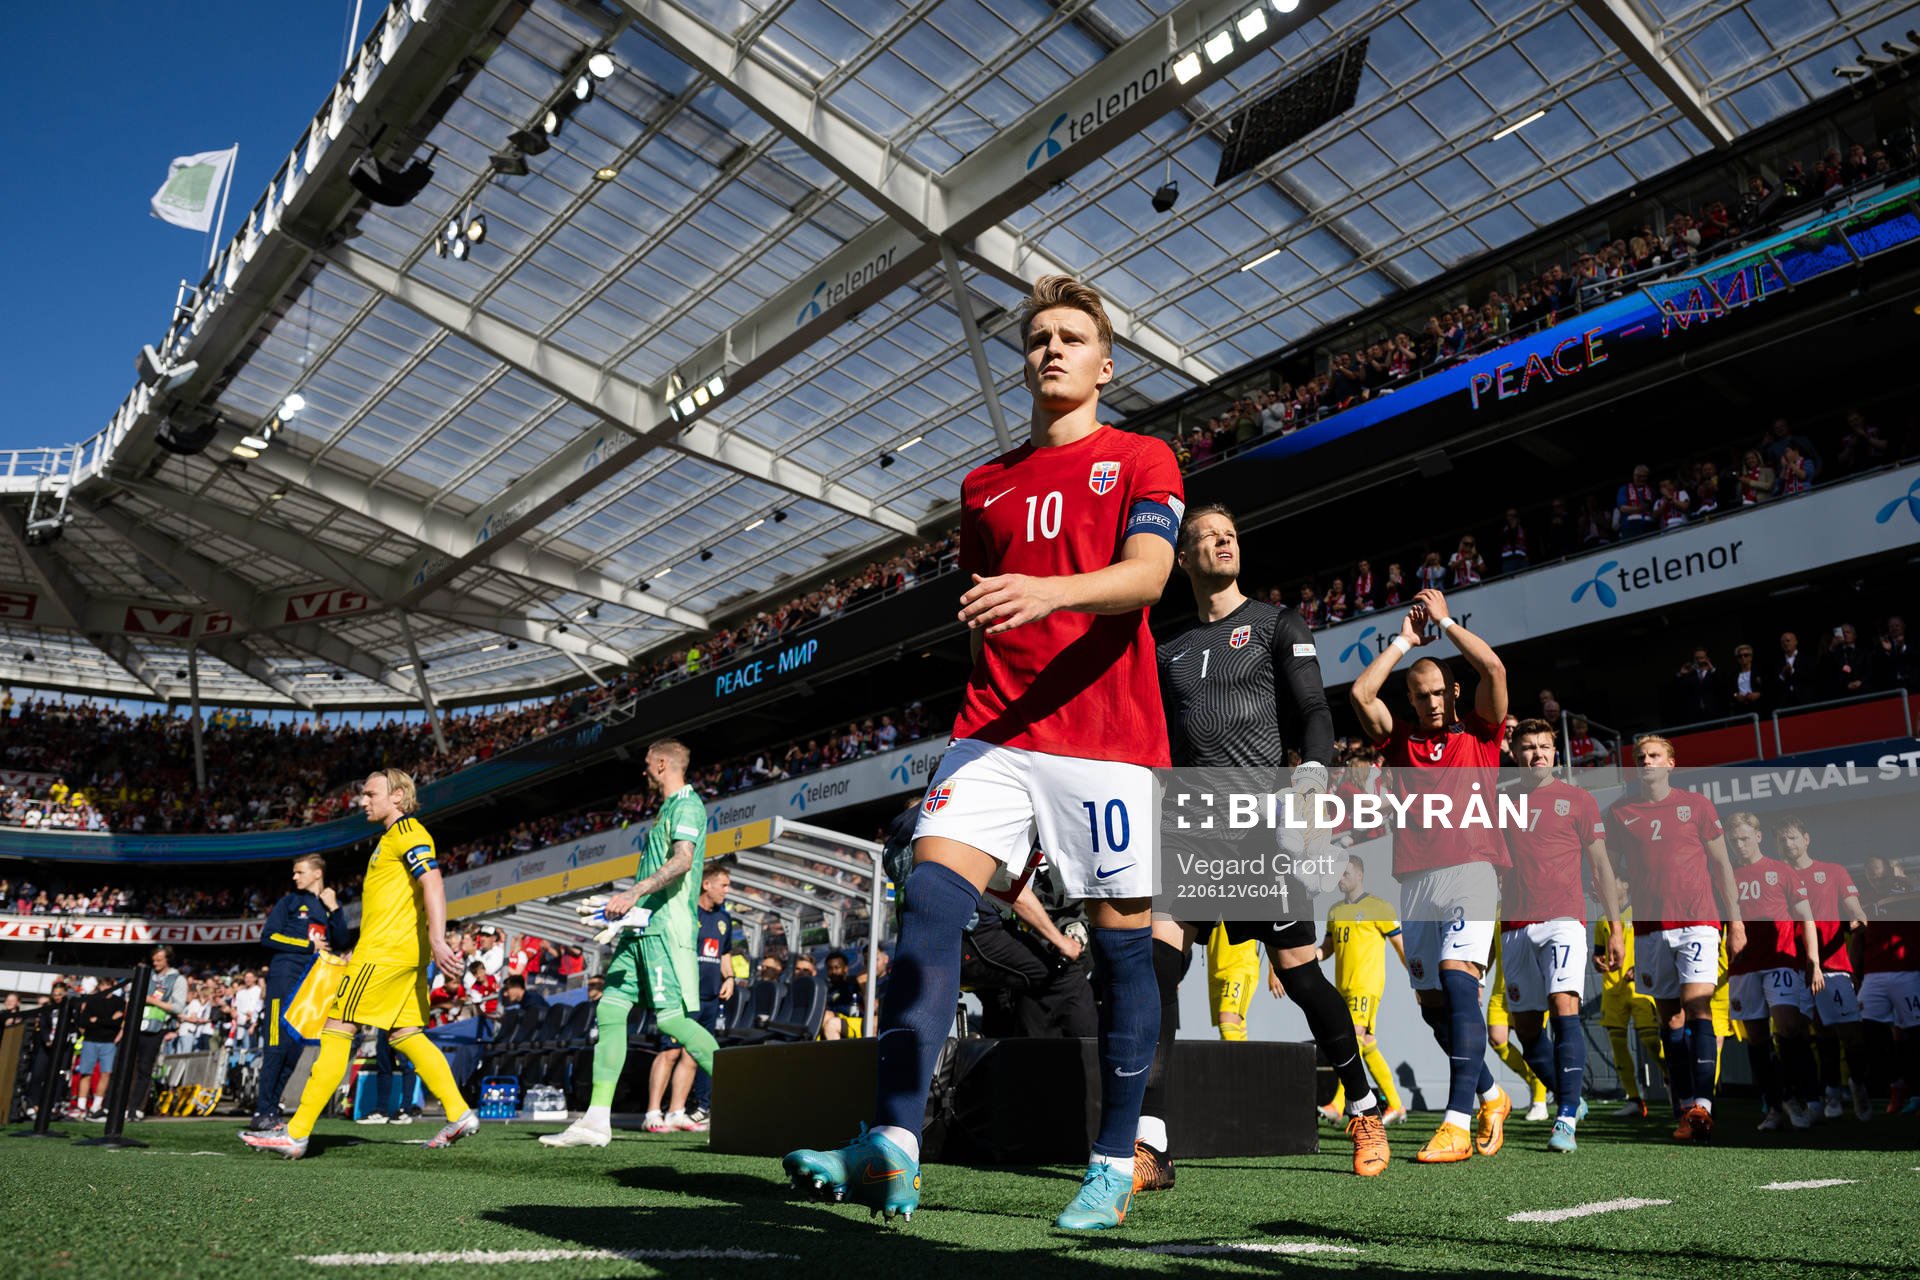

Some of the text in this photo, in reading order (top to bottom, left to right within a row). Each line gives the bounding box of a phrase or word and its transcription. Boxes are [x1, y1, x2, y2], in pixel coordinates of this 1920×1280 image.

[1069, 53, 1177, 143] telenor
[826, 246, 896, 307] telenor
[1470, 326, 1609, 409] PEACE
[1026, 491, 1063, 542] 10
[1136, 514, 1170, 527] RESPECT
[1618, 540, 1743, 592] telenor
[288, 590, 366, 617] VG
[1201, 649, 1210, 678] 1
[716, 660, 763, 697] PEACE
[1429, 743, 1445, 761] 3
[807, 779, 850, 802] telenor
[718, 803, 757, 826] telenor
[1083, 799, 1130, 853] 10
[1650, 819, 1662, 841] 2
[407, 851, 418, 864] C
[1275, 875, 1289, 914] 1
[1738, 880, 1761, 900] 20
[1453, 906, 1465, 931] 3
[134, 926, 185, 941] VG
[196, 926, 240, 941] VG
[1337, 926, 1350, 944] 18
[1551, 944, 1570, 969] 17
[1691, 942, 1702, 961] 2
[654, 966, 665, 991] 1
[1224, 982, 1241, 998] 13
[1772, 970, 1793, 988] 20
[1352, 996, 1368, 1012] 18
[1833, 989, 1843, 1007] 4
